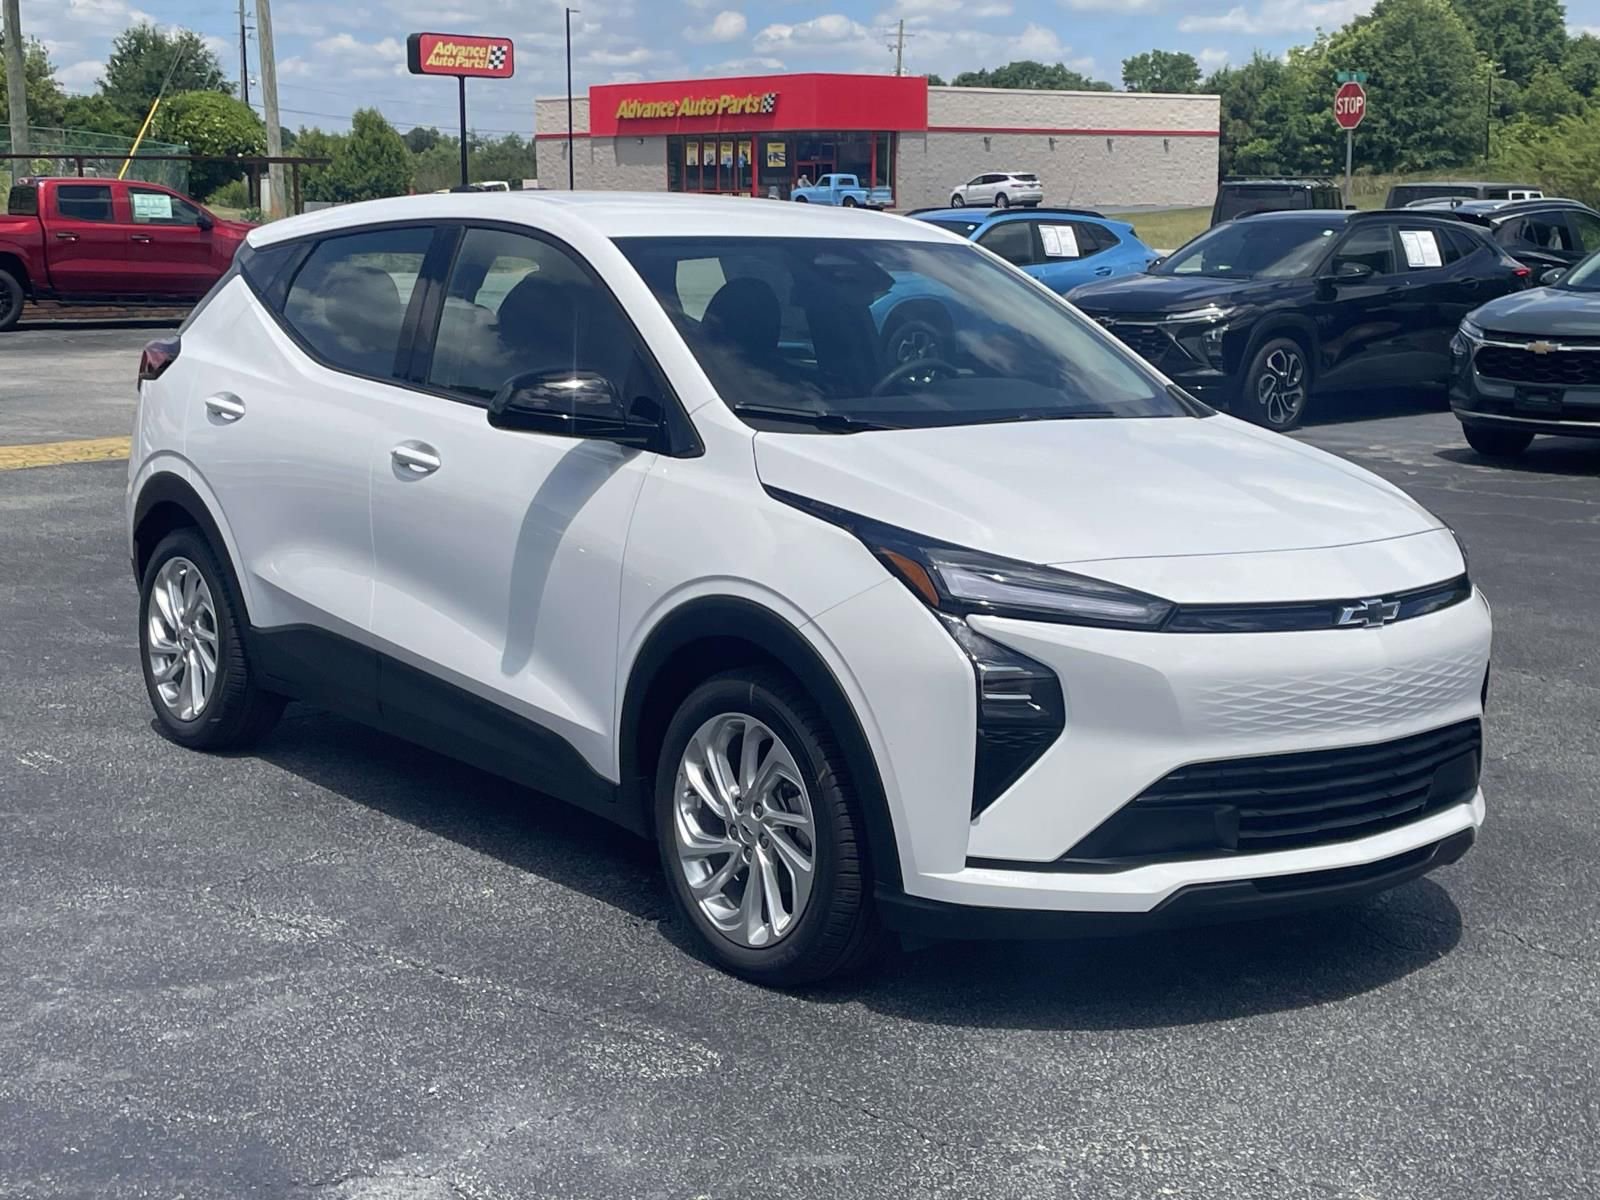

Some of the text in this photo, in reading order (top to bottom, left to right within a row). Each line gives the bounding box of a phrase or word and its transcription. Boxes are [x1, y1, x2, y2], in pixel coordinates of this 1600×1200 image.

[433, 41, 486, 57] Advance
[426, 55, 485, 69] Auto Parts
[616, 94, 761, 118] Advance Auto Parts
[1337, 96, 1363, 114] STOP
